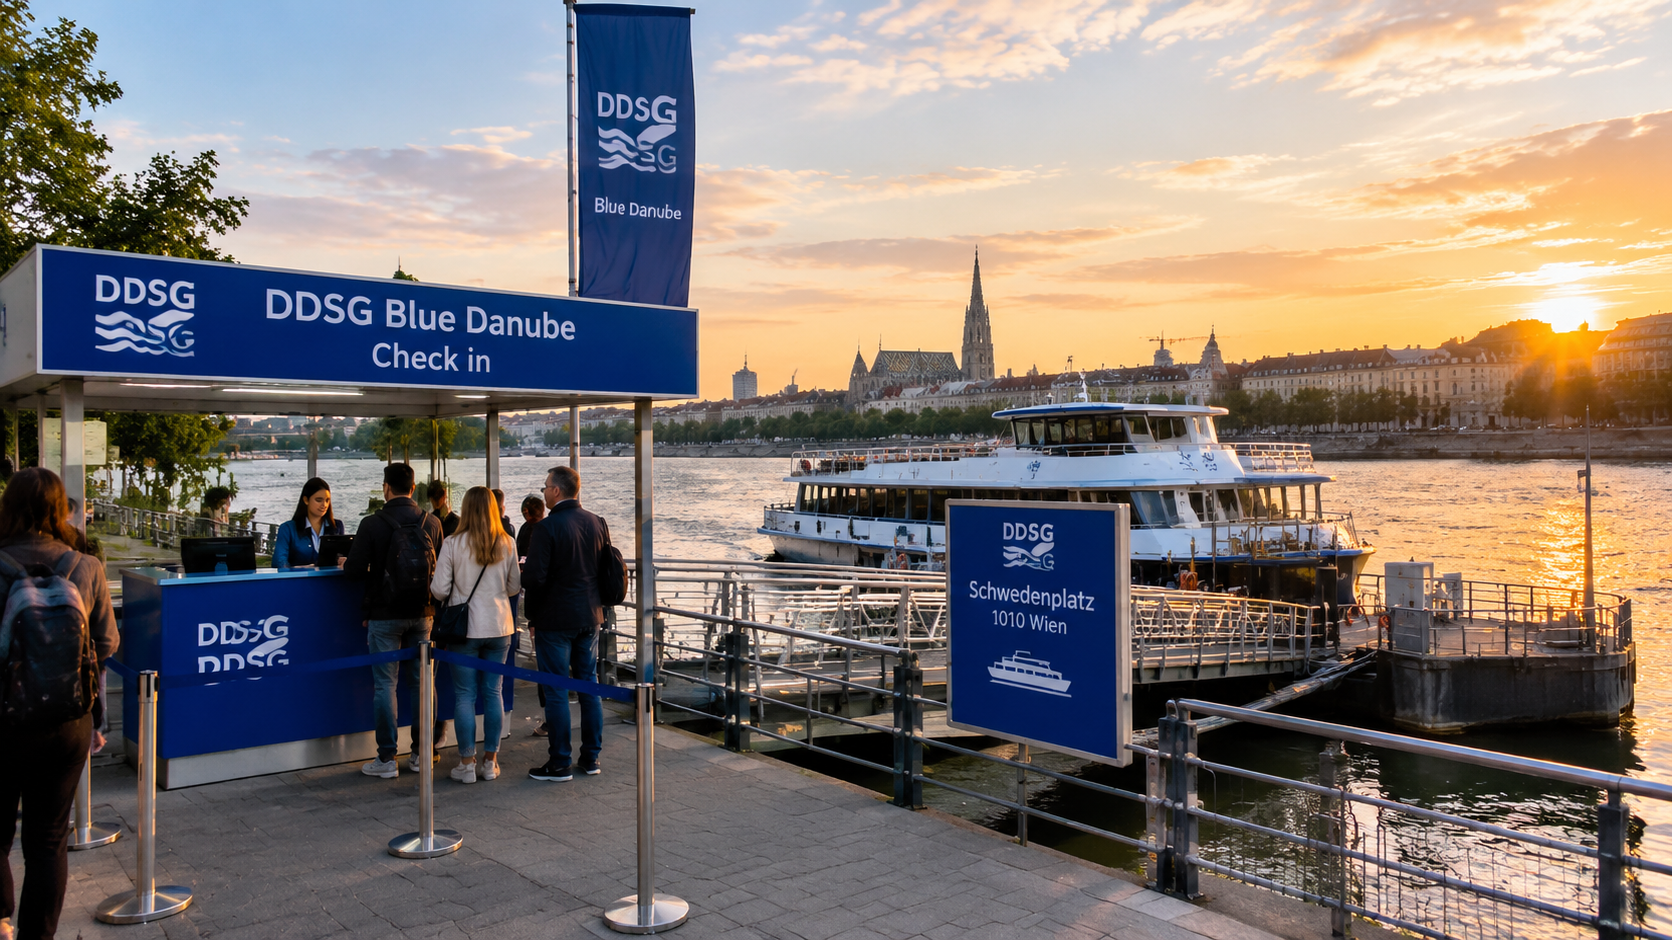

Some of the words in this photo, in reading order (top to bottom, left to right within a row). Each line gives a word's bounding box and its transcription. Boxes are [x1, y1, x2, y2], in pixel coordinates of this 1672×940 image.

[598, 92, 676, 123] DDSG
[595, 197, 625, 215] Blue
[630, 202, 681, 219] Danube
[96, 275, 194, 309] DDSG
[267, 289, 372, 325] DDSG
[387, 299, 455, 331] Blue
[467, 306, 575, 340] Danube
[373, 343, 458, 371] Check
[469, 347, 489, 372] in
[1004, 523, 1053, 541] DDSG
[970, 581, 1094, 611] Schwedenplatz
[993, 610, 1024, 628] 1010
[1030, 614, 1066, 634] Wien
